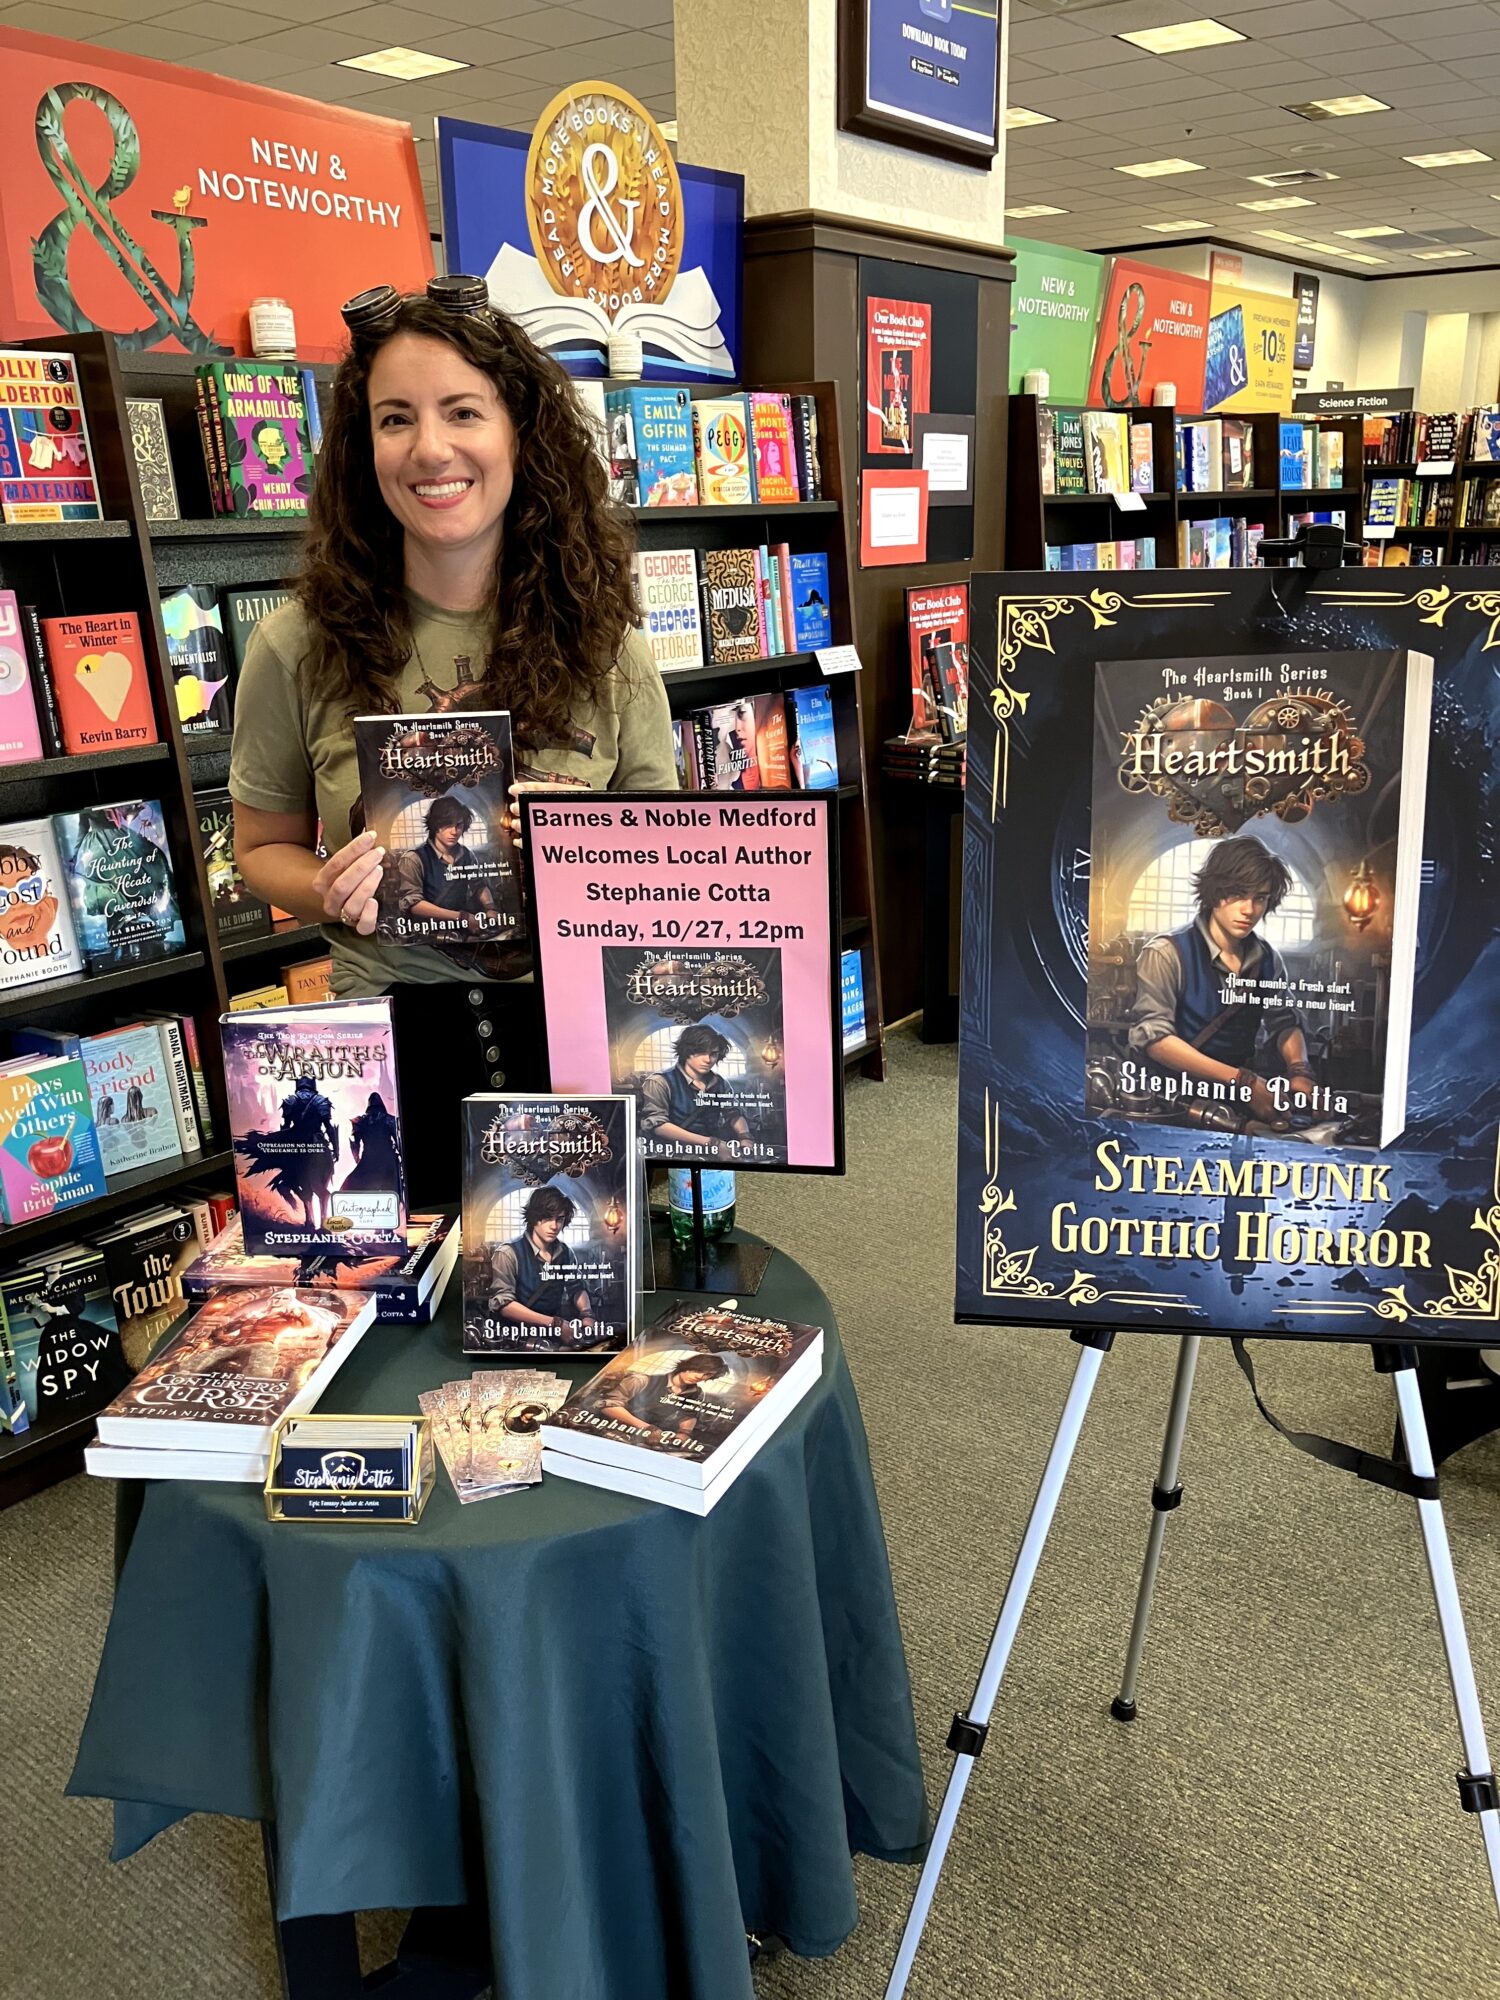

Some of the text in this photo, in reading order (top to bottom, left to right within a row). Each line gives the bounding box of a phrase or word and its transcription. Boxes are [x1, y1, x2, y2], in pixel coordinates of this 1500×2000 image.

[902, 23, 968, 61] DOWNLOAD NOOK TODAY
[250, 137, 347, 181] NEW &
[198, 167, 402, 228] NOTEWORTHY
[542, 107, 631, 278] READ MORE BOOKS
[587, 149, 670, 310] READ MORE BOOKS
[1041, 276, 1075, 297] NEW &
[874, 311, 925, 328] Our Book Club
[1018, 297, 1090, 323] NOTEWORTHY
[1170, 299, 1193, 318] NEW &
[1153, 318, 1204, 340] NOTEWORTHY
[1261, 329, 1277, 362] 10
[224, 374, 299, 395] KING OF THE
[227, 399, 304, 419] ARMADILLOS
[644, 405, 682, 420] EMILY
[1319, 396, 1388, 409] Science Fiction
[642, 423, 687, 439] GIFFIN
[1063, 422, 1080, 434] DAN
[647, 444, 687, 452] THE SUMMER
[707, 427, 746, 452] PEGGY
[1061, 436, 1082, 449] JONES
[660, 455, 676, 463] PACT
[1059, 458, 1083, 469] WOLVES
[4, 482, 92, 500] MATERIAL
[263, 482, 291, 494] WENDY
[1059, 476, 1083, 488] WINTER
[253, 498, 305, 511] CHIN-TANNER
[644, 555, 693, 577] GEORGE
[647, 582, 695, 605] GEORGE
[712, 586, 755, 610] MEDUSA
[59, 618, 131, 635] The Heart in
[649, 608, 697, 633] GEORGE
[31, 612, 44, 659] SWIM HOME
[79, 635, 118, 648] Winter
[651, 634, 699, 660] GEORGE
[1162, 663, 1328, 688] The Heartsmith Series
[1223, 686, 1253, 701] Book
[79, 727, 148, 745] Kevin Barry
[393, 720, 480, 733] The Heartsmith Series
[386, 746, 496, 770] Heartsmith
[730, 748, 748, 760] THE
[1130, 731, 1353, 777] Heartsmith
[532, 808, 817, 828] Barnes & Noble Medford
[107, 832, 134, 857] The
[542, 845, 812, 865] Welcomes Local Author
[85, 848, 158, 882] Haunting of
[112, 873, 152, 898] Hecate
[586, 883, 770, 905] Stephanie Cotta
[104, 891, 158, 918] Cavendish
[396, 912, 516, 935] Stephanie Cotta
[557, 920, 805, 942] Sunday, 10/27, 12pm
[644, 951, 743, 961] The Heartsmith Series
[633, 974, 761, 997] Heartsmith
[1225, 972, 1256, 989] Aaren
[1259, 978, 1287, 990] wants
[1290, 982, 1296, 990] a
[1299, 979, 1325, 992] fresh
[1218, 989, 1247, 1005] What
[1250, 993, 1261, 1005] he
[1263, 994, 1282, 1009] gets
[1285, 997, 1294, 1008] is
[1296, 1000, 1303, 1009] a
[1306, 999, 1326, 1010] new
[84, 1051, 135, 1077] Body
[256, 1042, 387, 1064] WRAITHS
[168, 1028, 192, 1112] BANAL NIGHTMARE
[274, 1057, 364, 1081] ARJUN
[11, 1076, 63, 1102] Plays
[87, 1065, 156, 1100] Friend
[1120, 1061, 1349, 1114] Stephanie Cotta
[0, 1088, 84, 1125] Well With
[498, 1103, 589, 1115] The Heartsmith Series
[11, 1111, 76, 1140] Others
[109, 1141, 177, 1167] Katherine Brabon
[487, 1131, 604, 1155] Heartsmith
[637, 1136, 775, 1158] Stephanie Cotta
[1095, 1139, 1392, 1203] STEAMPUNK
[30, 1171, 81, 1196] Sophie
[22, 1182, 94, 1214] Brickman
[336, 1199, 395, 1219] Autographed
[264, 1232, 402, 1245] STEPHANIE COTTA
[1049, 1201, 1432, 1268] GOTHIC HORROR
[143, 1253, 172, 1279] the
[9, 1274, 98, 1305] MEGAN CAMPISI
[50, 1328, 77, 1344] THE
[484, 1319, 614, 1340] Stephanie Cotta
[676, 1316, 785, 1353] Heartsmith
[20, 1334, 110, 1372] WIDOW
[41, 1360, 100, 1396] SPY
[156, 1374, 290, 1393] CONJURER'S
[210, 1371, 245, 1380] THE
[136, 1385, 280, 1411] CURSE
[119, 1407, 267, 1423] STEPHANIE COTTA
[571, 1410, 705, 1453] Stephanie Cotta
[294, 1469, 395, 1488] Stephanie Cotta
